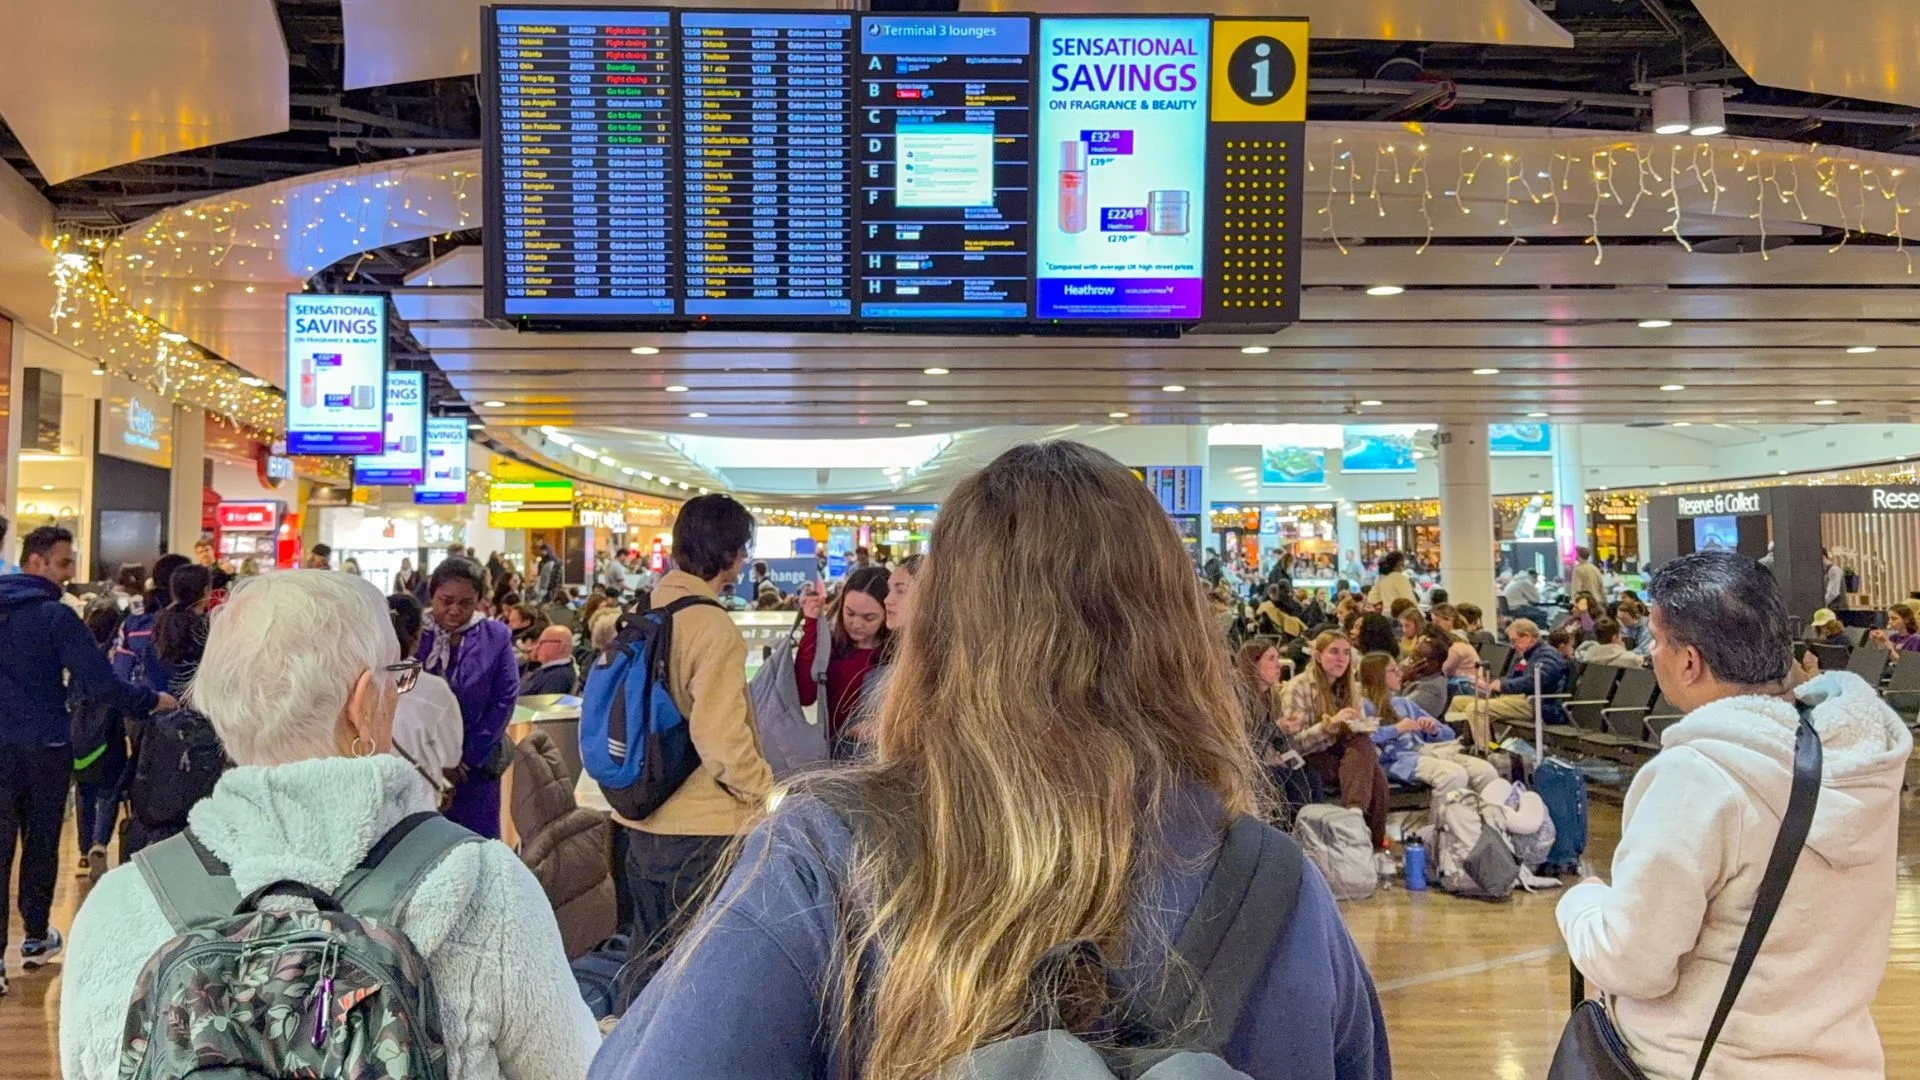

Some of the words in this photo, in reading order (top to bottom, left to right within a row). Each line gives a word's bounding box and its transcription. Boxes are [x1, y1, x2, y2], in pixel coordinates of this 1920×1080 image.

[884, 24, 936, 36] Terminal
[939, 25, 946, 36] 3
[949, 25, 996, 39] lounges
[1052, 38, 1198, 56] SENSATIONAL
[868, 57, 882, 70] A
[1052, 64, 1197, 92] SAVINGS
[869, 84, 880, 97] B
[1049, 100, 1067, 110] ON
[1070, 100, 1137, 110] FRAGRANCE
[1140, 100, 1149, 110] &
[1152, 100, 1197, 110] BEAUTY
[869, 110, 880, 123] C
[869, 140, 882, 152] D
[869, 165, 878, 178] E
[869, 191, 878, 204] F
[869, 225, 878, 238] F
[869, 255, 881, 268] H
[869, 280, 881, 293] H
[1064, 284, 1115, 295] Heathrow
[296, 305, 378, 316] SENSATIONAL
[296, 318, 377, 335] SAVINGS
[1678, 496, 1714, 515] Reserve
[1715, 498, 1724, 513] &
[1725, 492, 1760, 512] Collect
[1872, 488, 1920, 509] Rese
[749, 568, 806, 584] Ehange
